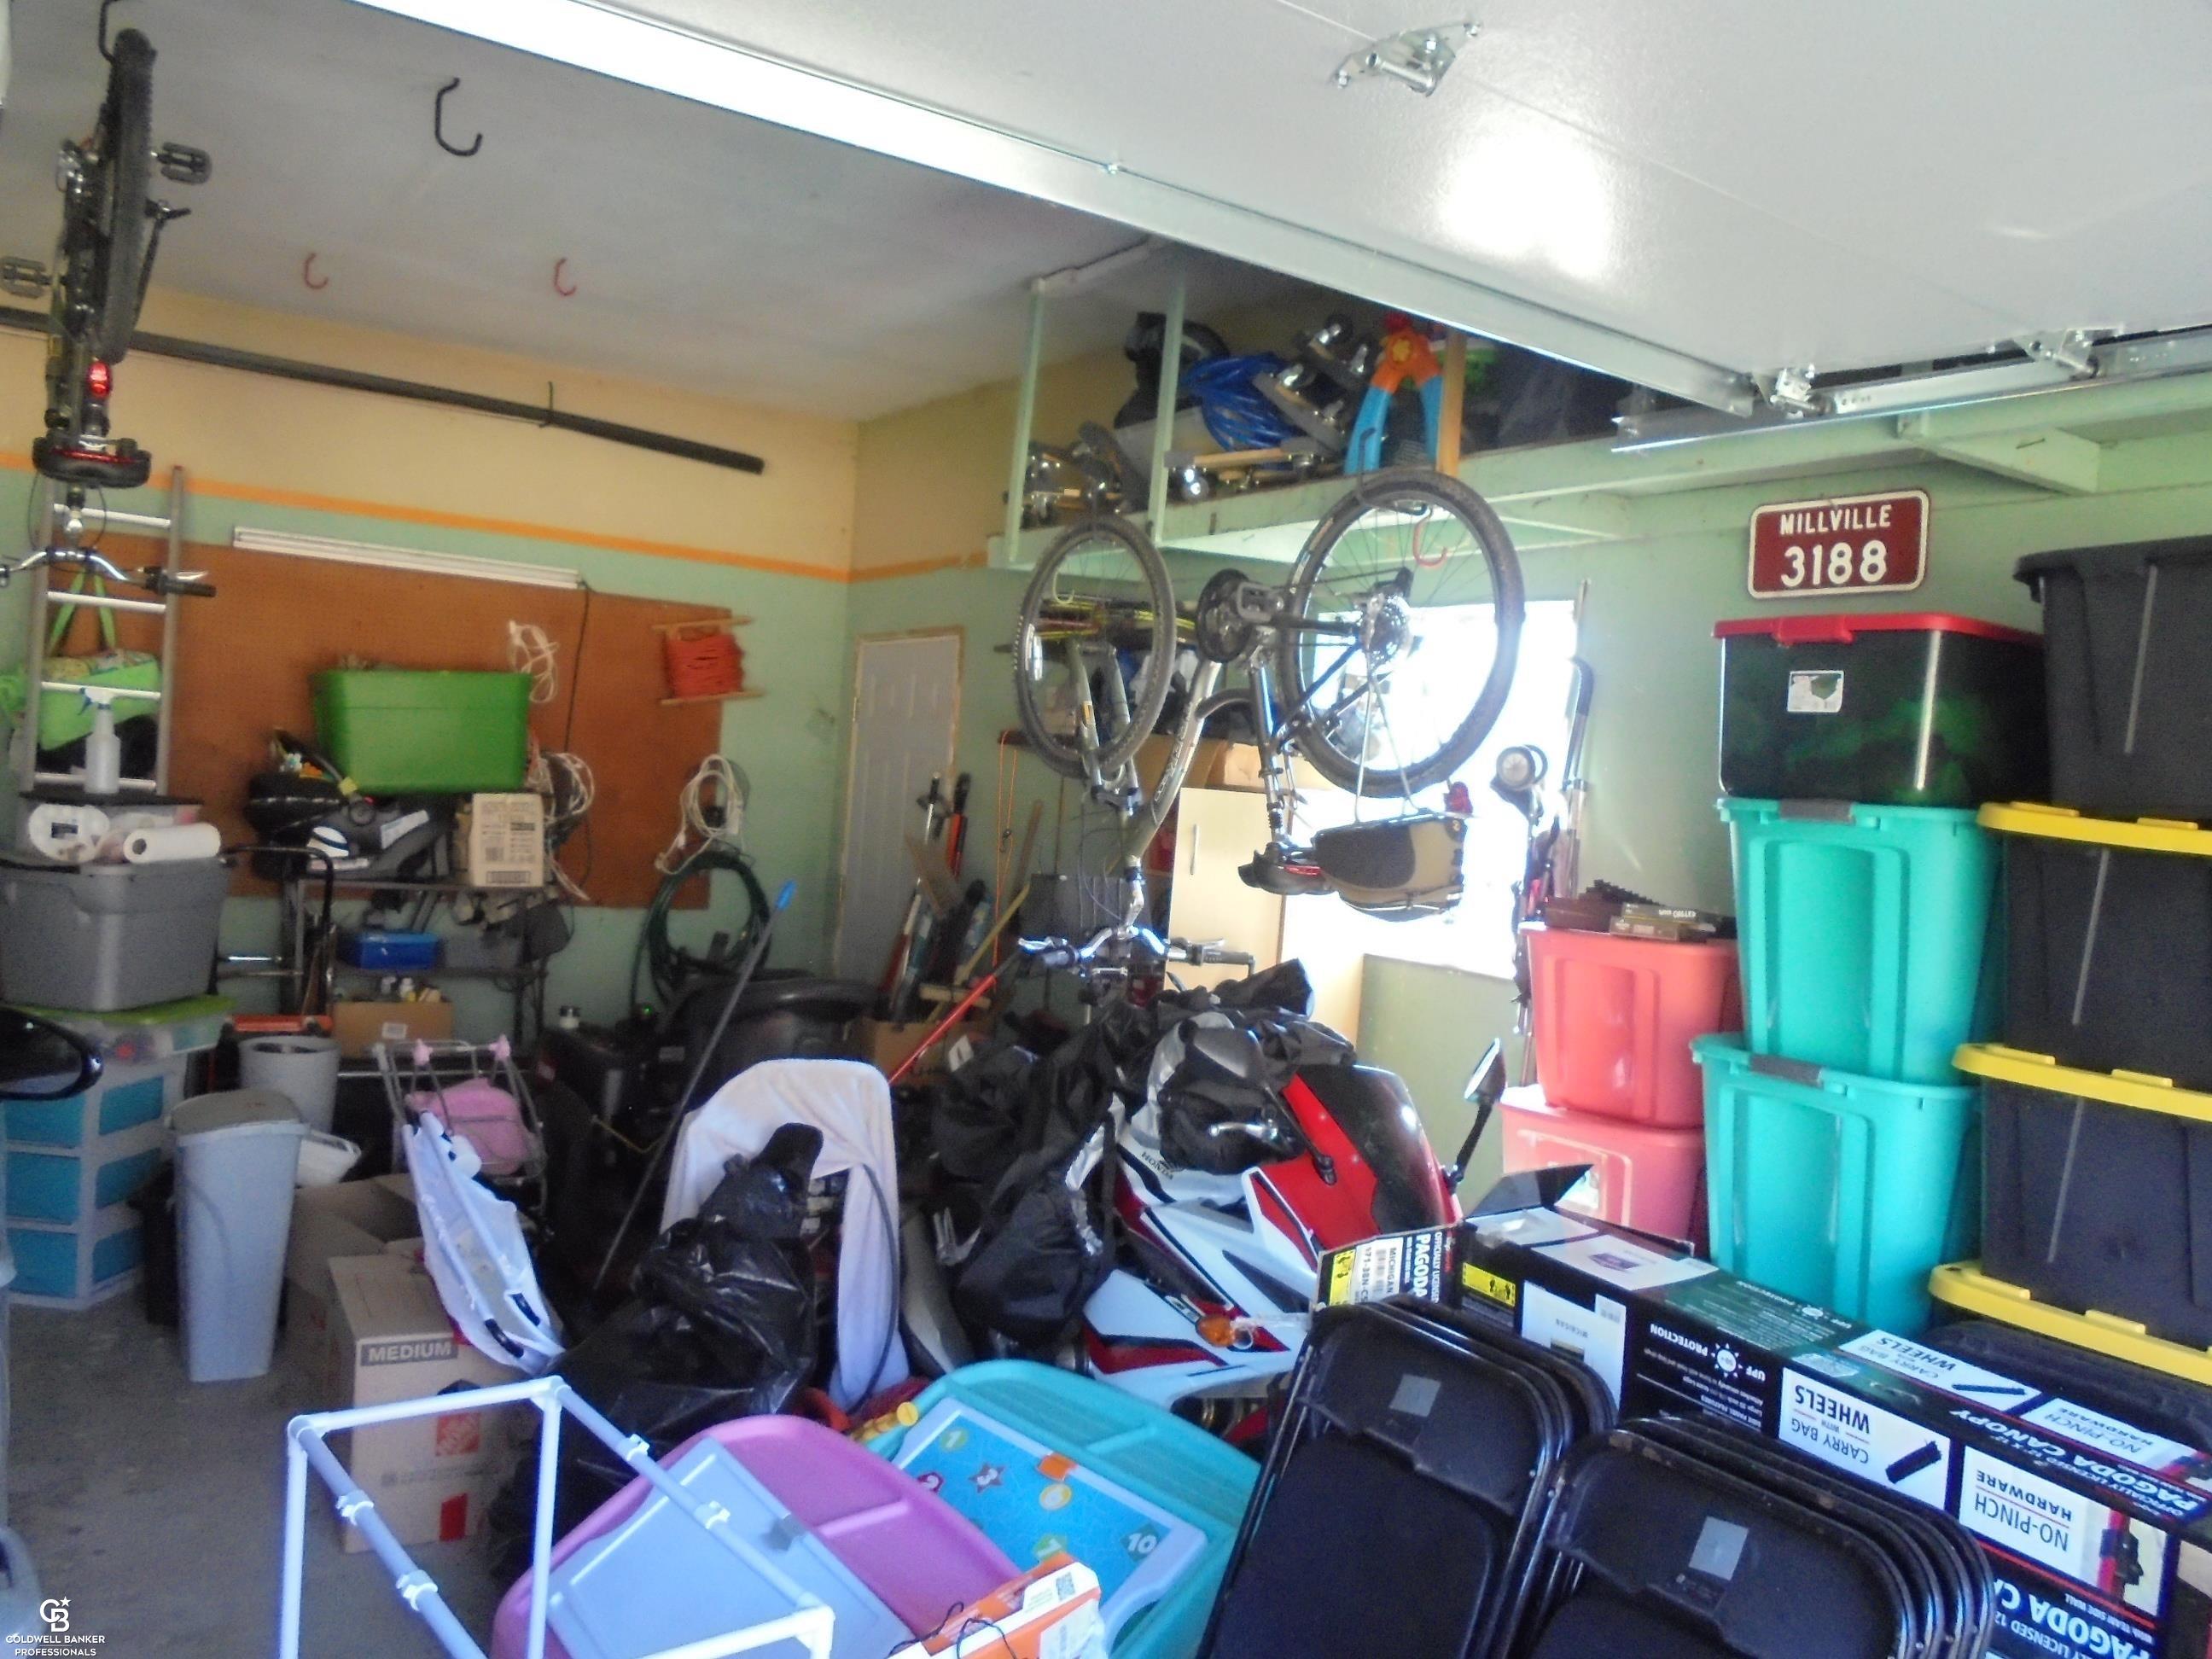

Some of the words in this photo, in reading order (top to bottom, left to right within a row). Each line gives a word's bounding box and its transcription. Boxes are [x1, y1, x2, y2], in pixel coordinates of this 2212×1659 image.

[1780, 504, 1892, 535] MILLVILLE
[1781, 539, 1887, 587] 3188
[1387, 1248, 1397, 1293] MICHIGAN
[1412, 1233, 1431, 1297] PAGODA
[369, 1342, 451, 1362] MEDIUM
[1650, 1324, 1708, 1356] PROTECTION
[1877, 1337, 1956, 1371] WHEELS
[1746, 1366, 1767, 1382] UPF
[1795, 1385, 1870, 1434] WHEELS
[2058, 1407, 2153, 1446] HARDWARE
[1791, 1418, 1819, 1441] BAG
[1824, 1434, 1869, 1464] CARRY
[1949, 1409, 2066, 1457] CANOPY
[2046, 1413, 2140, 1453] NO-PINCH
[1977, 1470, 2072, 1522] HARDWARE
[2073, 1455, 2198, 1511] PAGODA
[1975, 1493, 2068, 1551] NO-PINCH
[1128, 1533, 1156, 1552] 10
[2011, 1620, 2069, 1657] LICENSED
